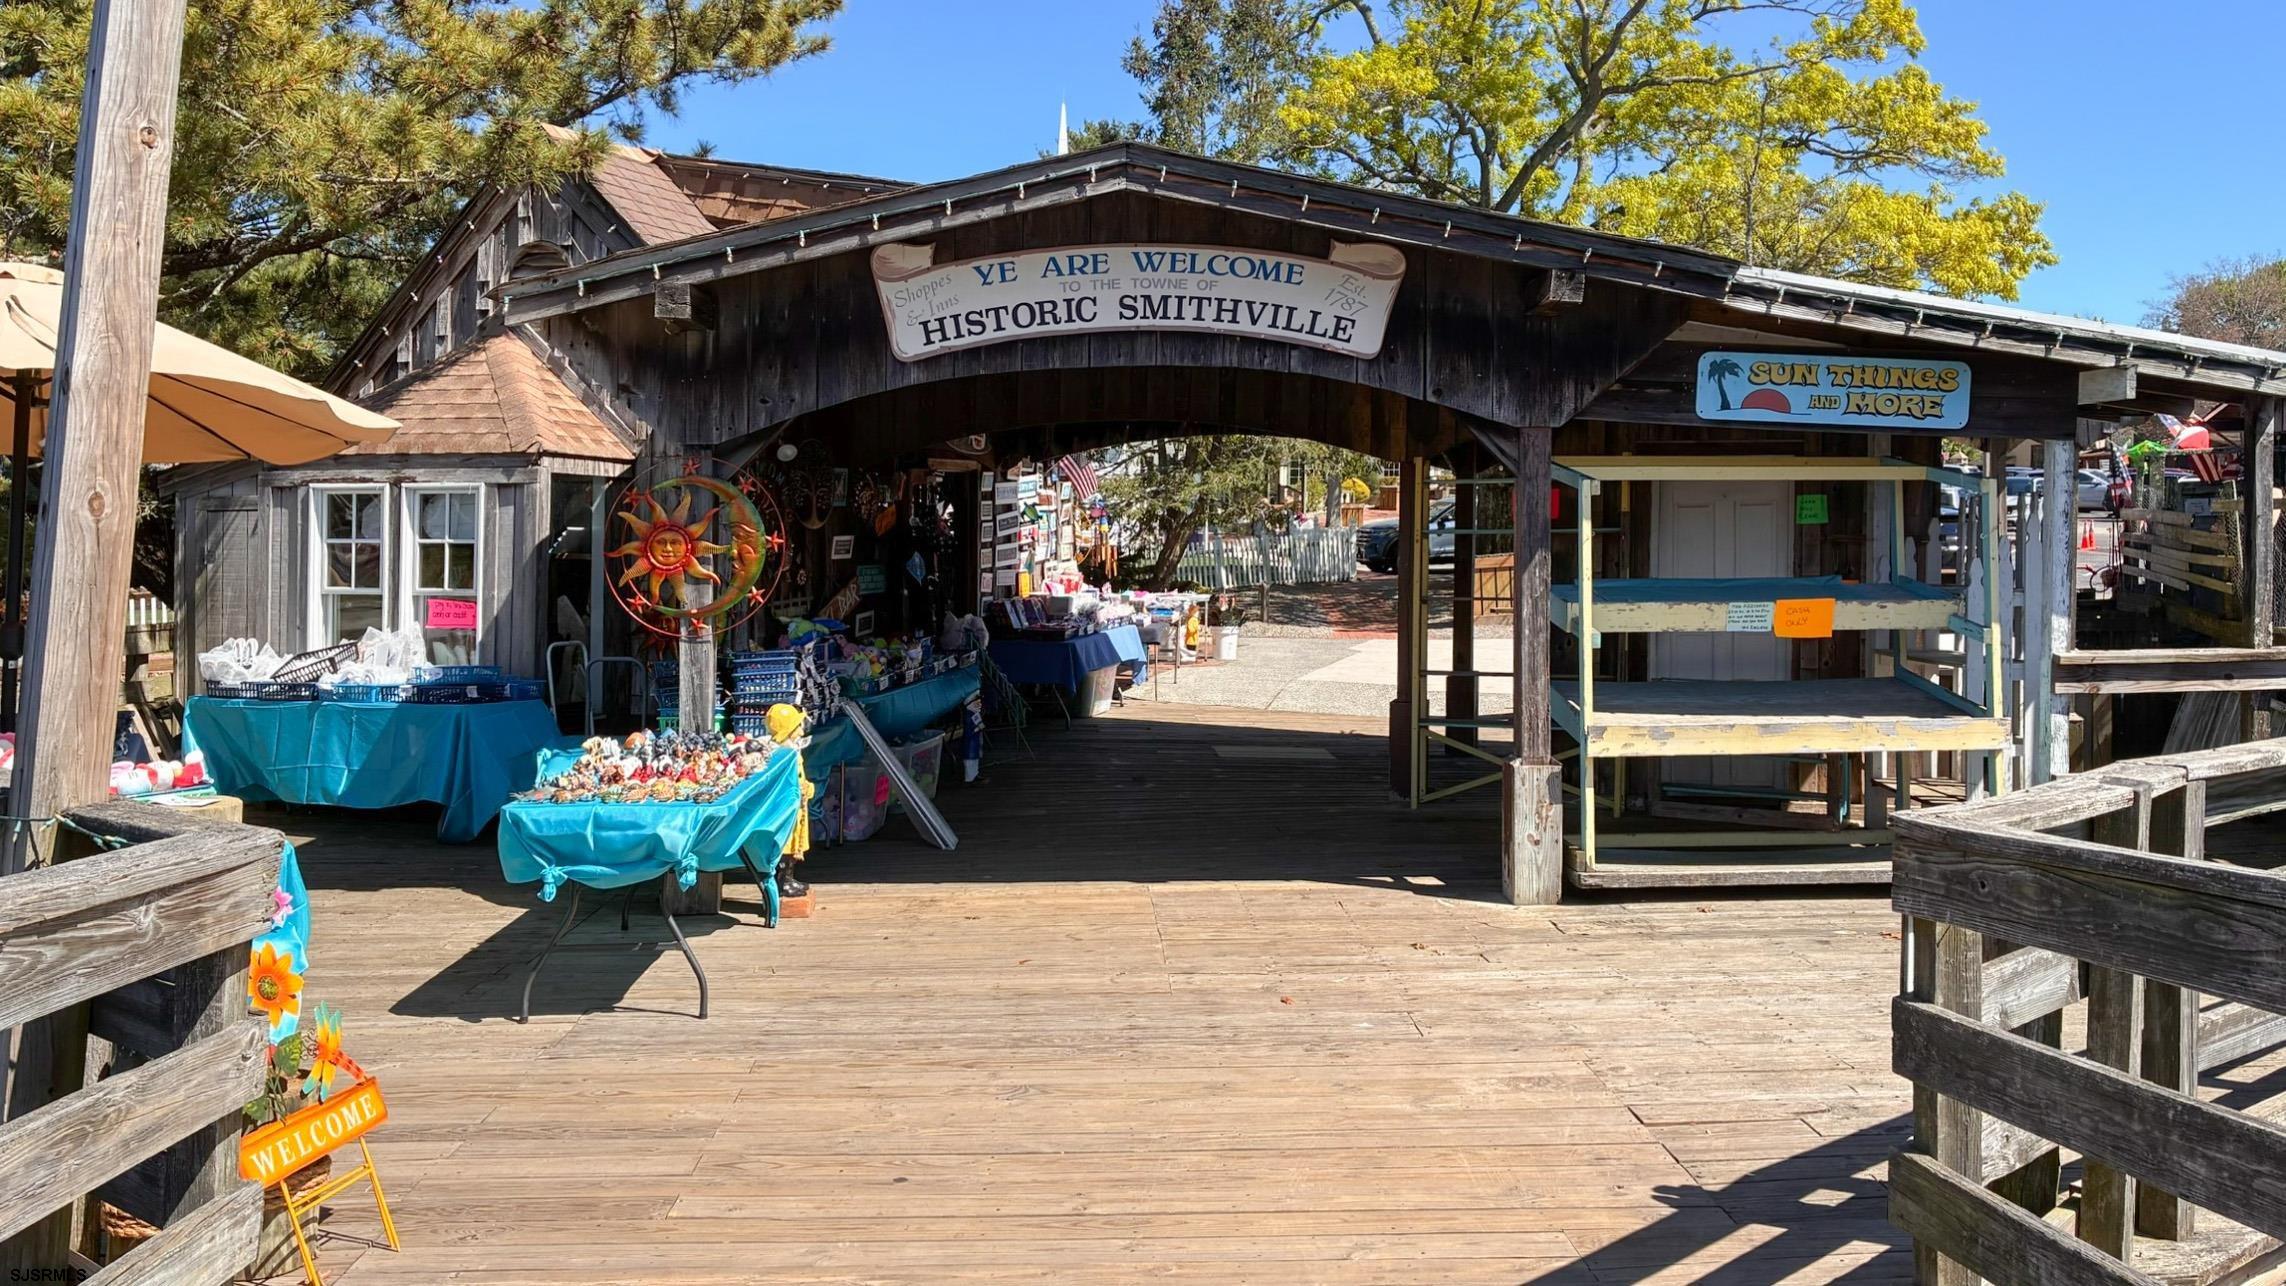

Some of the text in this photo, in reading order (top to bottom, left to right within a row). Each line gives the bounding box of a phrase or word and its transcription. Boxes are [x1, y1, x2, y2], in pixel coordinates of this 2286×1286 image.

[972, 251, 1305, 287] YE ARE WELCOME
[894, 274, 952, 308] Shoppes
[1059, 277, 1219, 293] TO THE TOWNE OF
[1338, 274, 1366, 299] Est.
[929, 294, 960, 317] Inns
[1324, 287, 1368, 317] 1787
[918, 294, 1356, 347] HISTORIC SMITHVILLE
[1748, 360, 1960, 392] SUN THINGS
[1807, 391, 1946, 420] AND MORE
[250, 1094, 377, 1178] WELCOME
